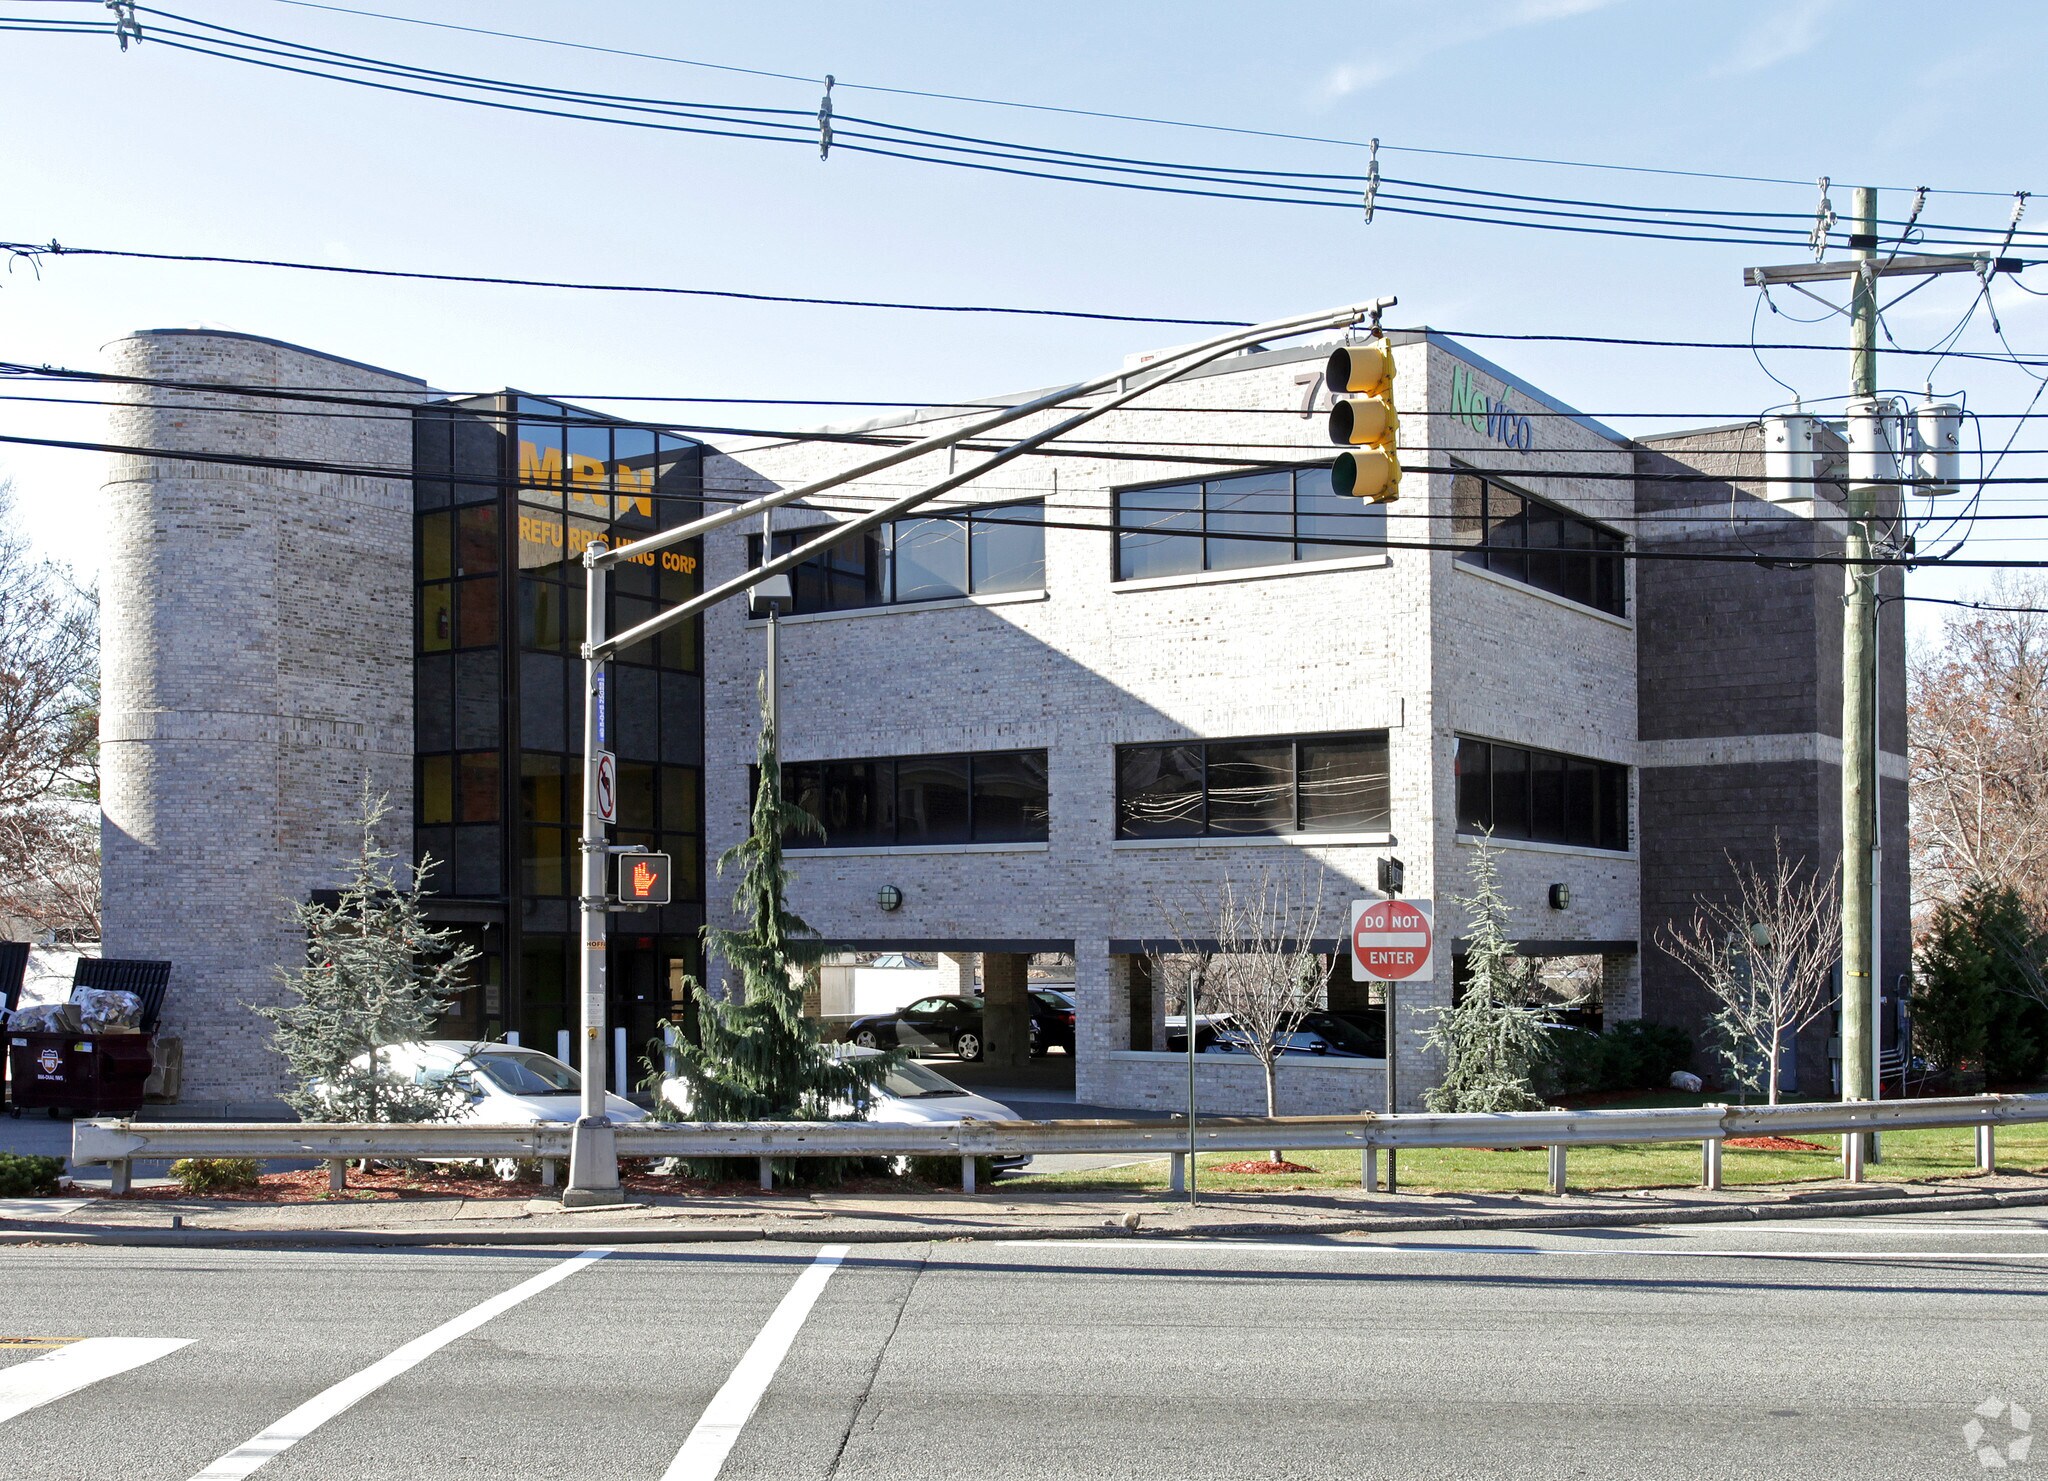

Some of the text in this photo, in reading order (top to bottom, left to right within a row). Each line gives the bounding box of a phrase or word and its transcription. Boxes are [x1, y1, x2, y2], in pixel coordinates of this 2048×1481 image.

[519, 439, 652, 518] MRN
[661, 551, 697, 575] CORP
[1365, 916, 1420, 928] DO NOT
[1370, 952, 1414, 965] ENTER
